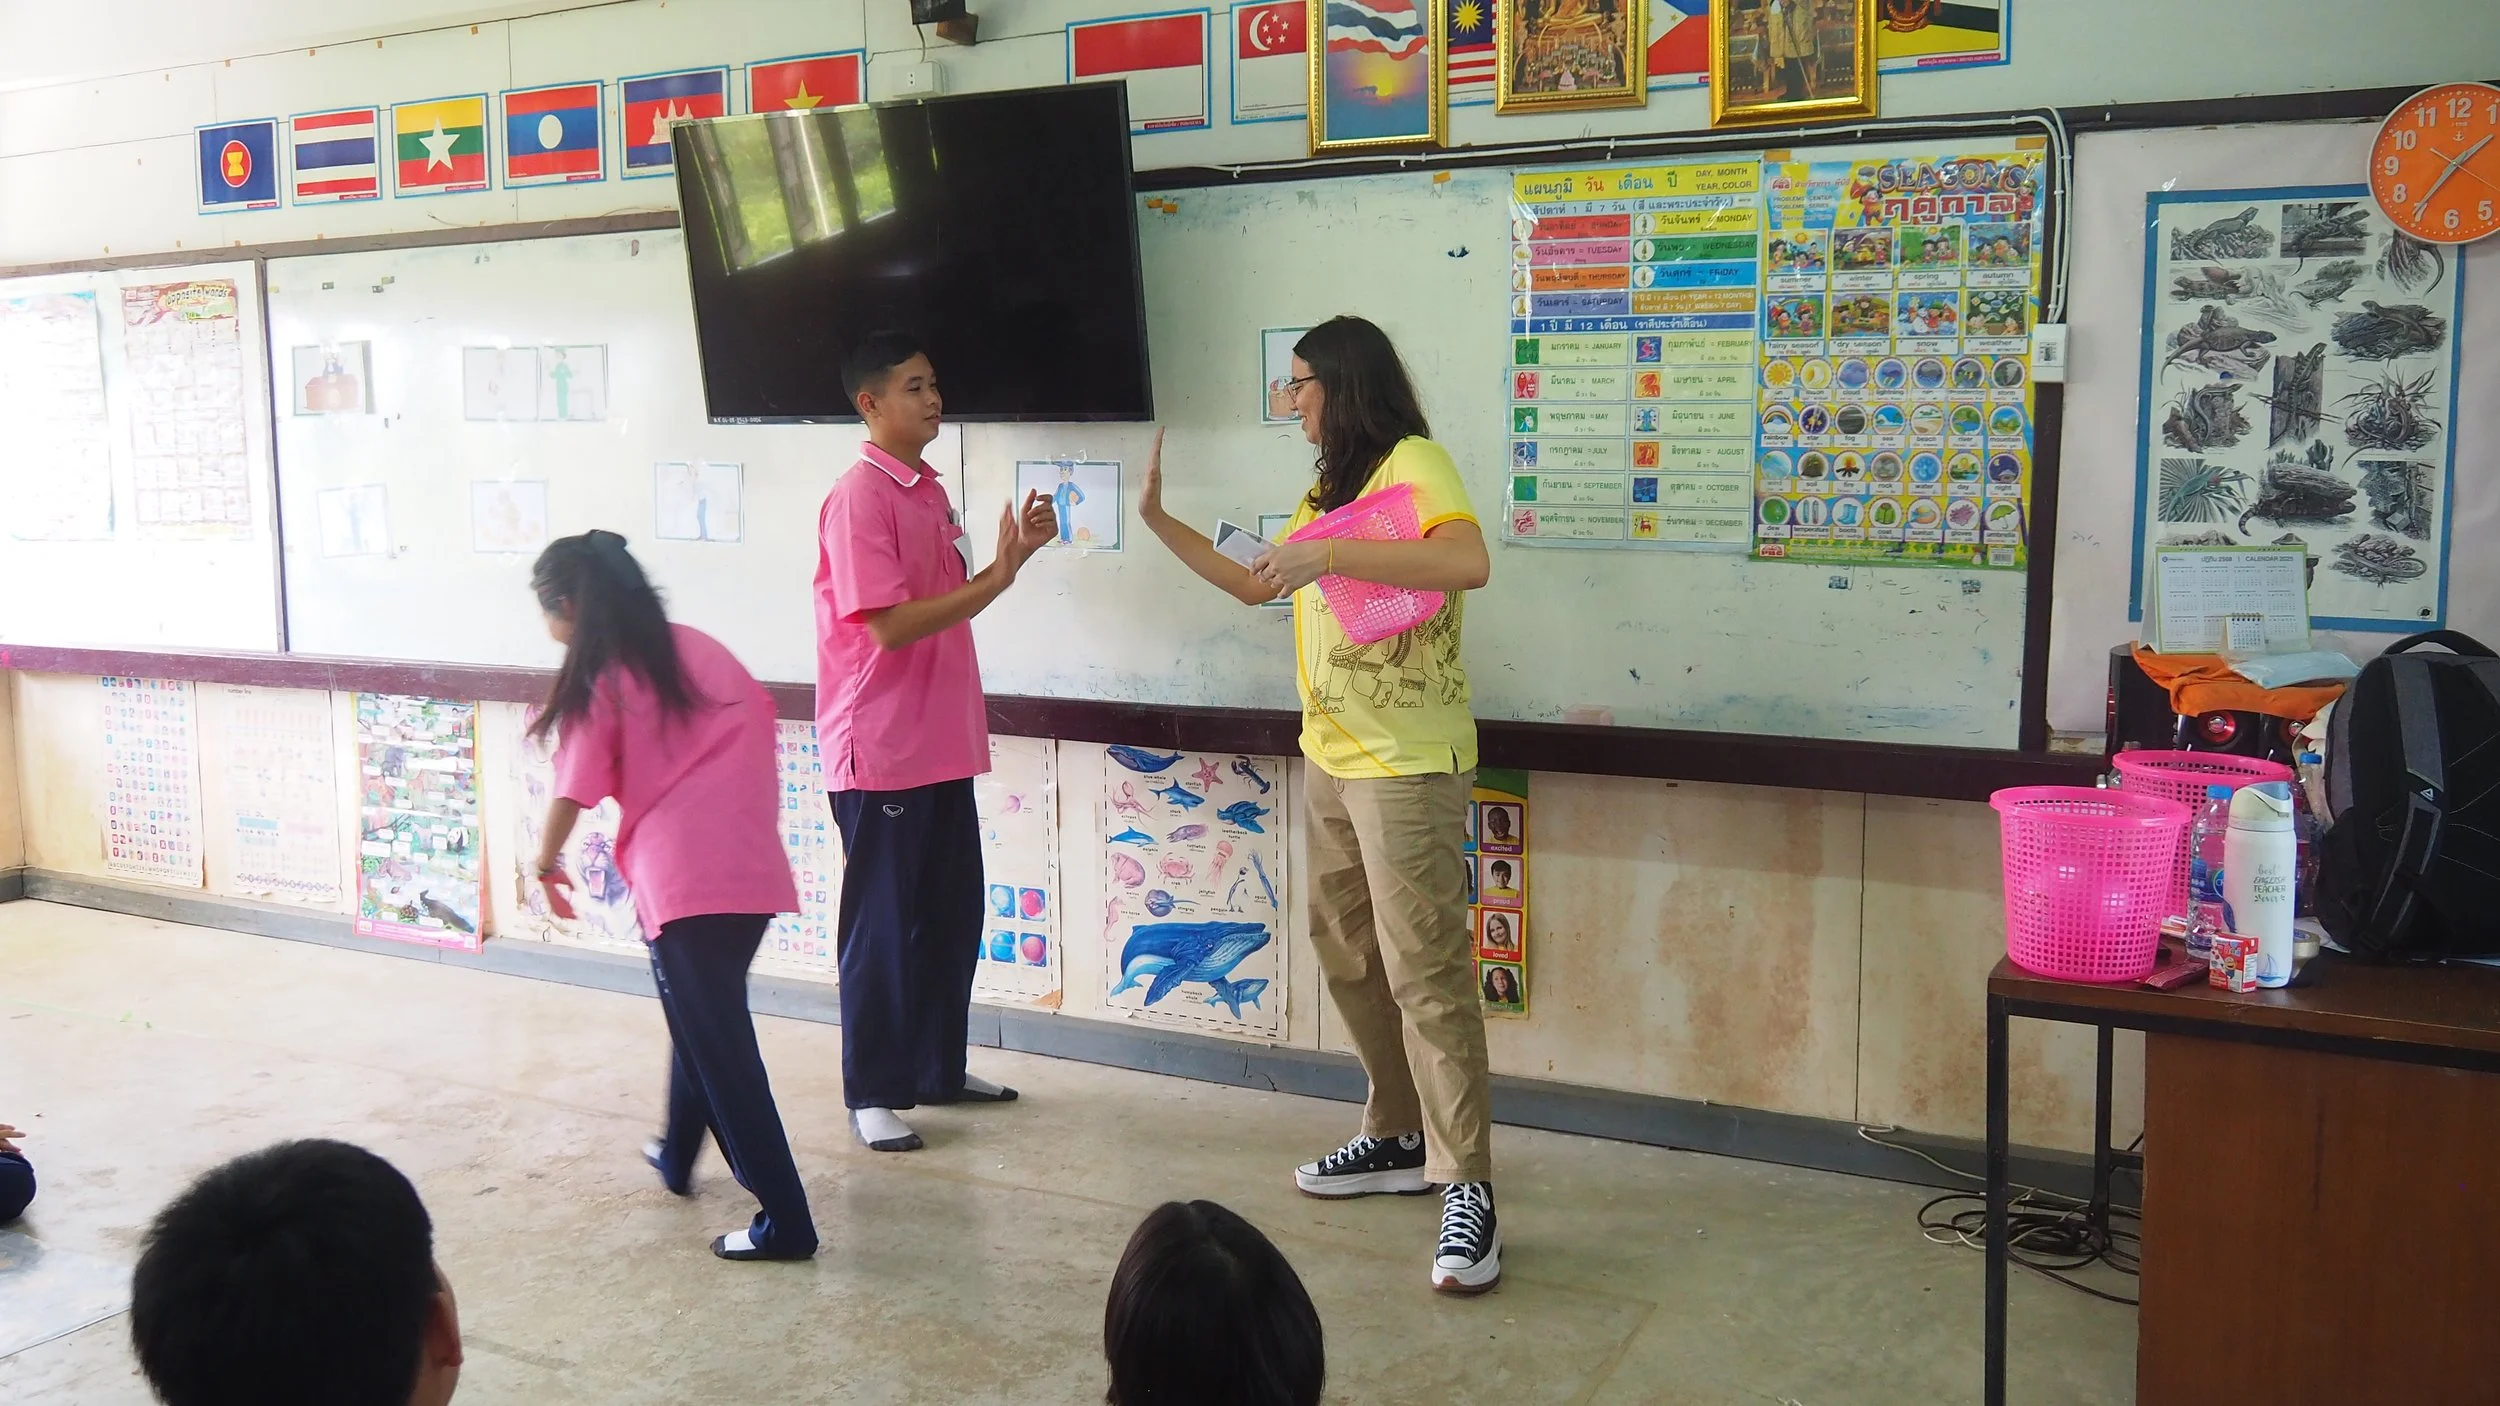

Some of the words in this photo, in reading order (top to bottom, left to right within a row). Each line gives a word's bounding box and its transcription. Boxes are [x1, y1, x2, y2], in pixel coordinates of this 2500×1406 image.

[2446, 97, 2472, 119] 12
[2414, 106, 2437, 128] 11
[2486, 103, 2497, 125] 1
[2392, 129, 2417, 151] 10
[2384, 155, 2399, 176] 9
[1717, 167, 1747, 176] MONTH
[1877, 158, 2027, 193] SEASONS
[1524, 177, 1573, 199] แผนภูมิ
[1585, 177, 1604, 192] วัน
[1618, 173, 1653, 191] เดือน
[1667, 172, 1678, 188] ปี
[1722, 181, 1752, 190] COLOR
[2392, 183, 2407, 204] 8
[1612, 201, 1626, 211] วัน
[1884, 192, 2018, 225] ฤดูกาล
[2477, 200, 2493, 221] 5
[1716, 213, 1753, 223] MONDAY
[2443, 208, 2460, 229] 6
[1702, 240, 1756, 250] WEDNESDAY
[1587, 246, 1622, 254] TUESDAY
[1588, 273, 1626, 281] THURSDAY
[1709, 268, 1739, 277] FRIDAY
[1913, 272, 1939, 282] spring
[1982, 271, 2014, 280] autumn
[1780, 275, 1812, 284] summer
[205, 286, 228, 298] words
[1581, 297, 1624, 306] SATURDAY
[1580, 321, 1593, 331] 12
[1600, 317, 1628, 330] เดือน
[1591, 342, 1622, 350] JANUARY
[1717, 339, 1753, 348] FEBRUARY
[1791, 341, 1819, 349] season
[1837, 340, 1851, 349] dry
[1979, 339, 2012, 347] weather
[1591, 377, 1616, 385] MARCH
[1717, 376, 1737, 384] APRIL
[1876, 389, 1904, 397] lightning
[1717, 412, 1735, 420] JUNE
[1717, 448, 1745, 456] AUGUST
[1583, 482, 1623, 490] SEPTEMBER
[1706, 483, 1740, 492] OCTOBER
[1957, 483, 1970, 491] day
[1588, 516, 1624, 524] NOVEMBER
[1705, 519, 1743, 527] DECEMBER
[1951, 530, 1972, 538] gloves
[2258, 864, 2277, 875] best
[2253, 876, 2286, 884] ENGLISH
[2253, 884, 2286, 893] TEACHER
[1492, 897, 1511, 905] proud
